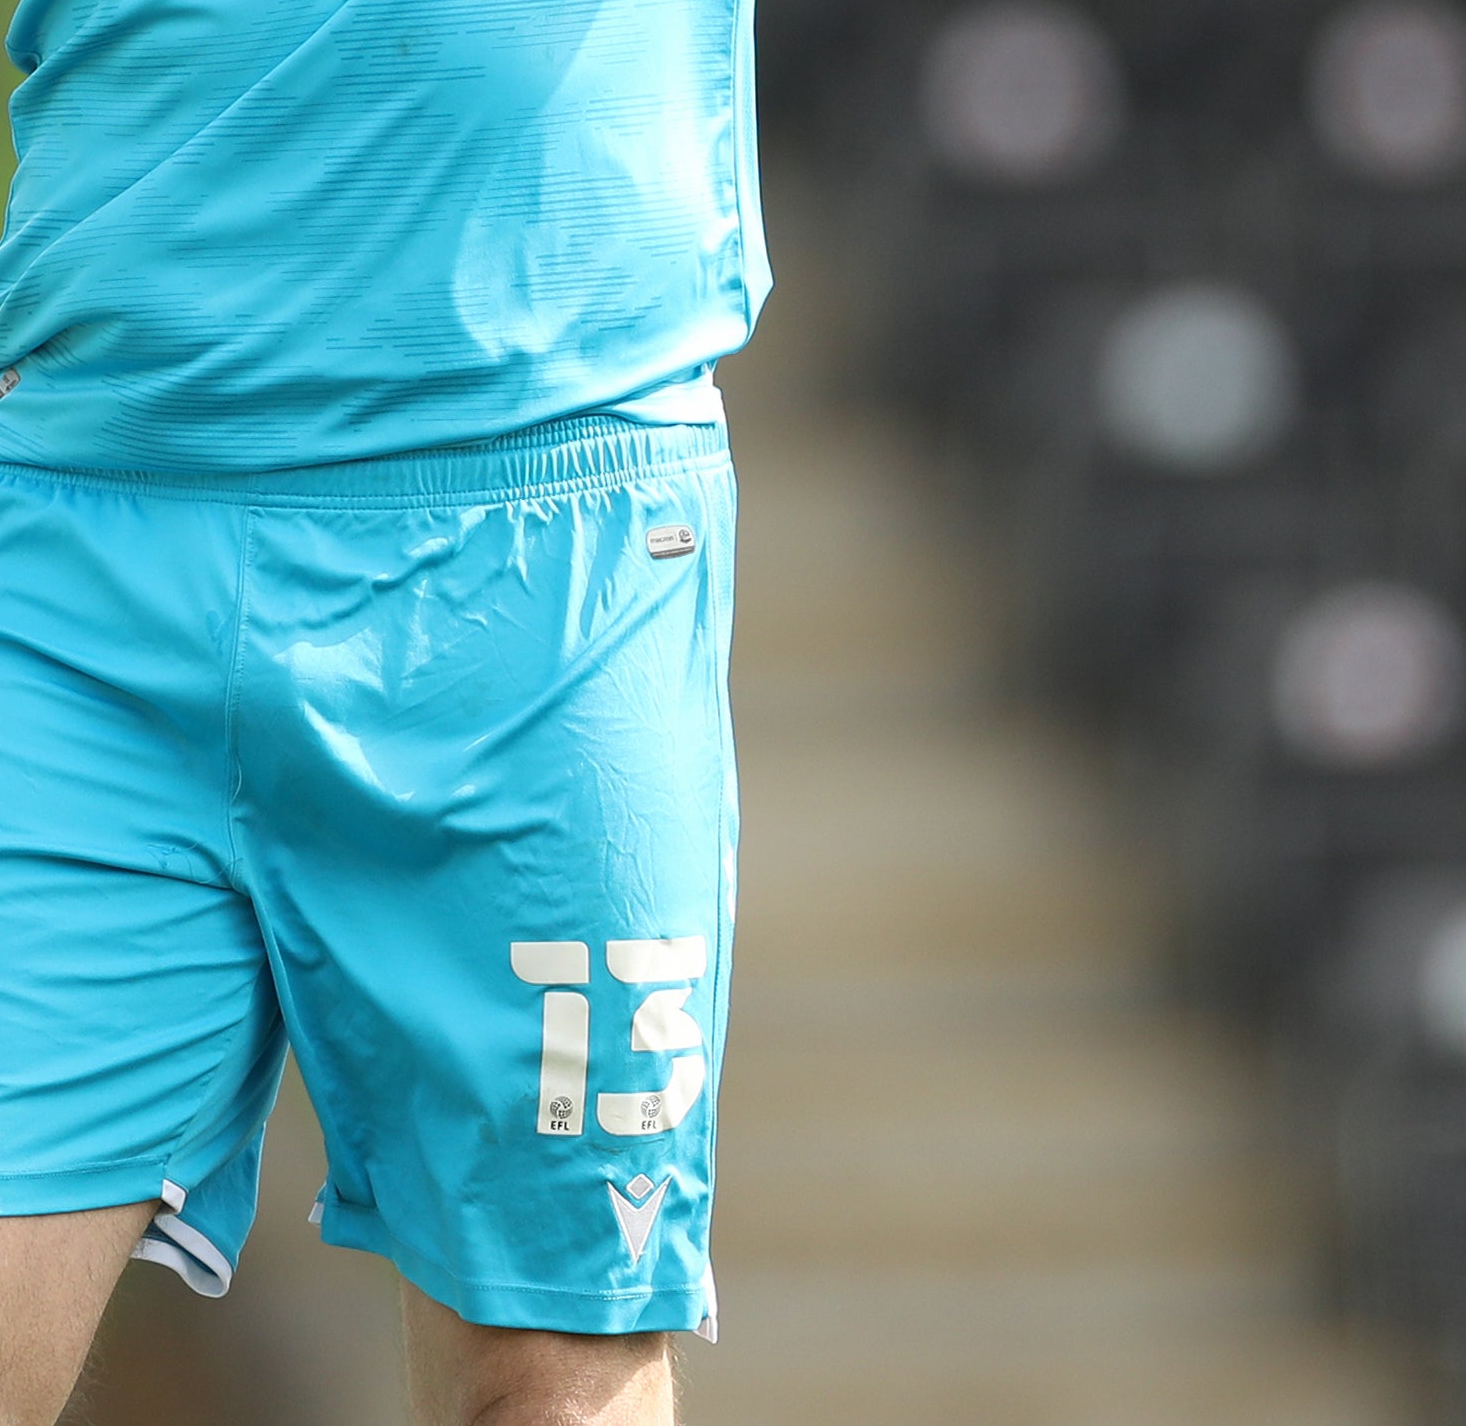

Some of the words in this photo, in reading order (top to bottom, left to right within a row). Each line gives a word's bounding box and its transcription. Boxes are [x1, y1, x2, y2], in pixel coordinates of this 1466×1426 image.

[510, 936, 708, 1136] 13
[550, 1120, 570, 1131] EFL
[641, 1120, 657, 1130] EFL
